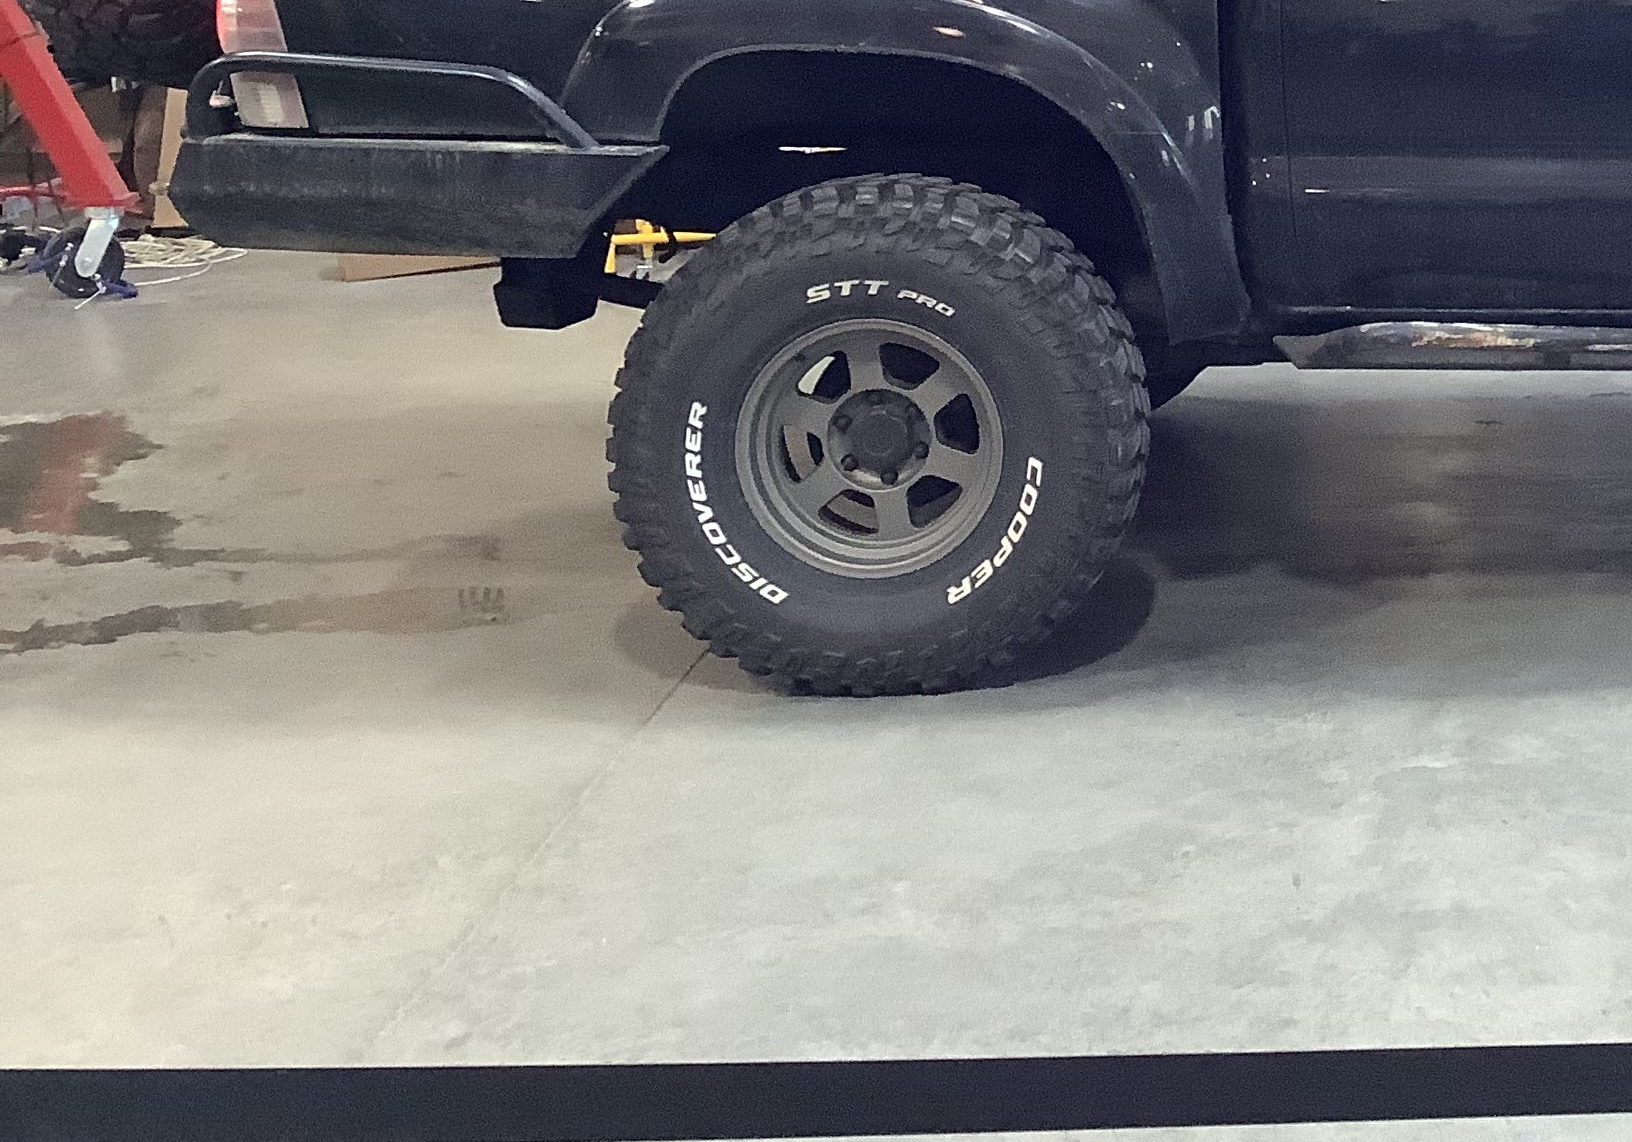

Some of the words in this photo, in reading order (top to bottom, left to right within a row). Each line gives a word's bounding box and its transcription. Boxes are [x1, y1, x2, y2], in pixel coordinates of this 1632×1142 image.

[805, 278, 890, 305] STT
[896, 288, 957, 318] PRO
[683, 400, 789, 605] DISCOVERER
[946, 455, 1044, 606] COOPER
